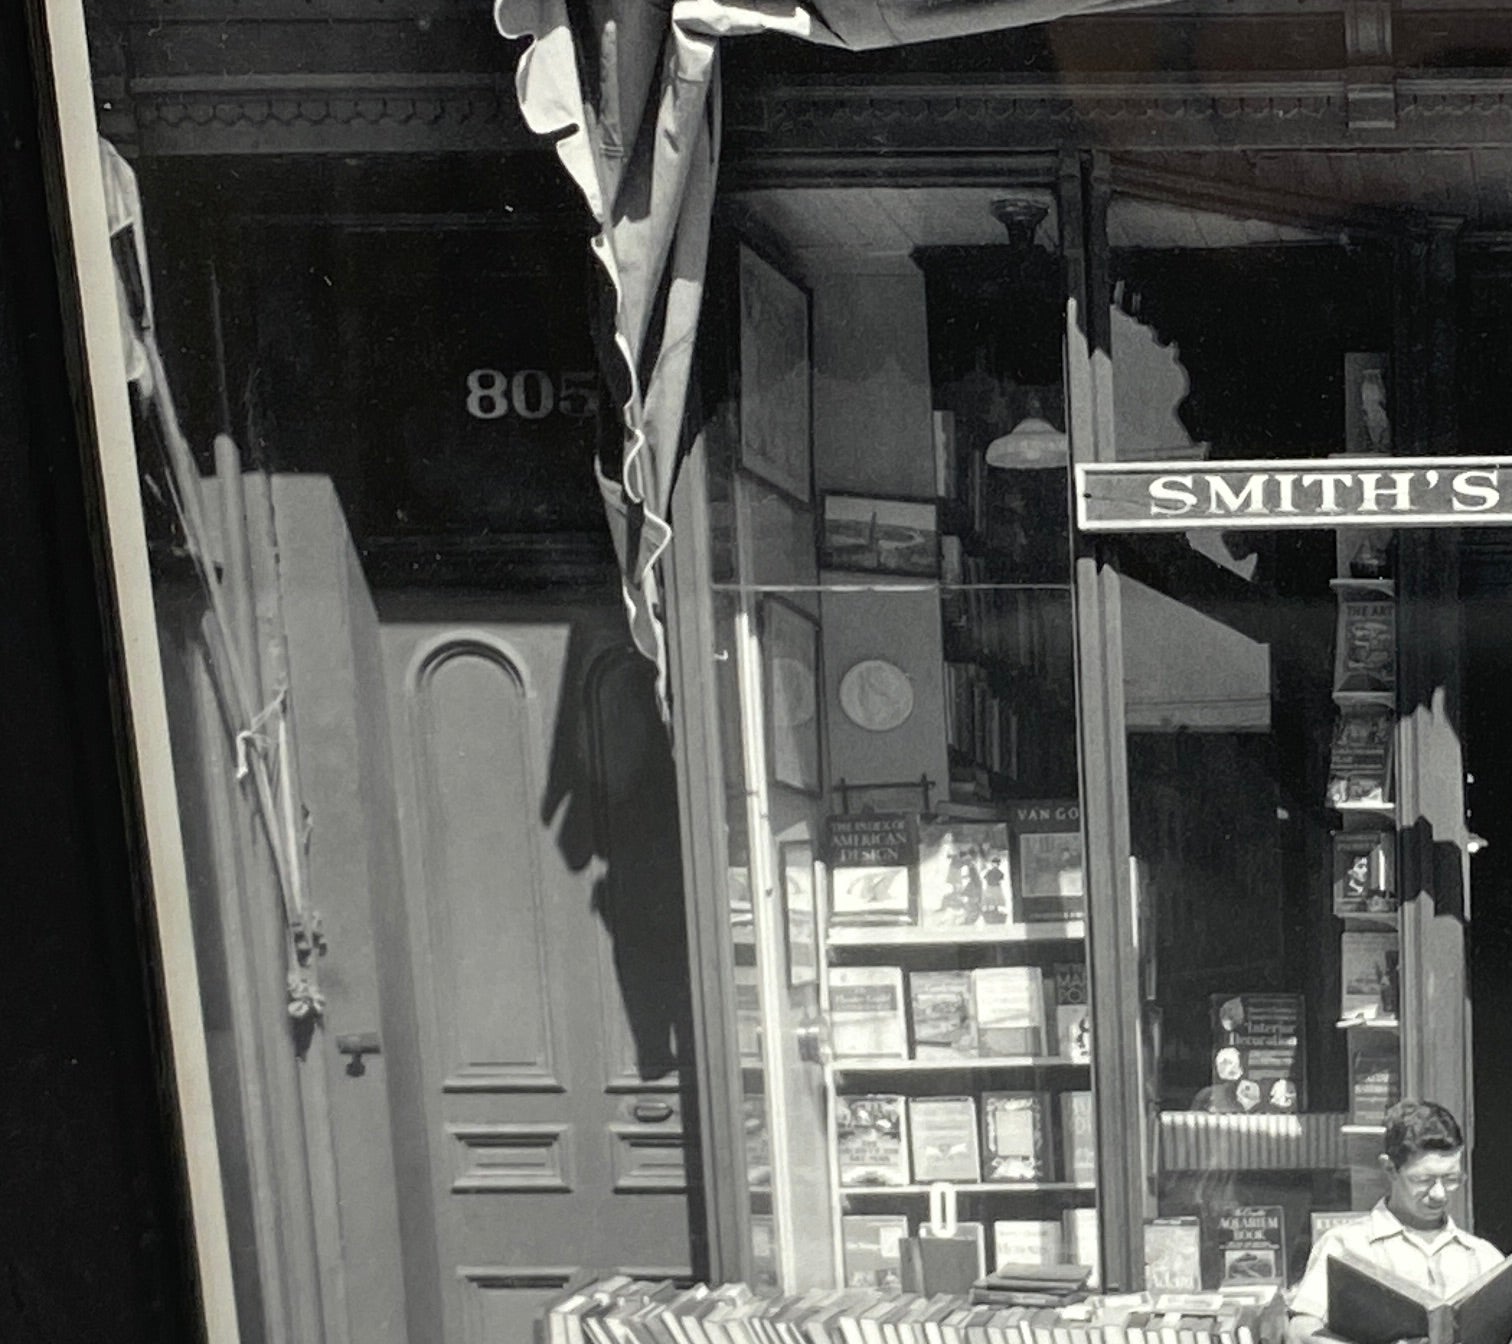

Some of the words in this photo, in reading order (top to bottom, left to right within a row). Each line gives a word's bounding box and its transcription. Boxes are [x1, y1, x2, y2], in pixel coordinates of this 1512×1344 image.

[466, 368, 598, 419] 805
[1148, 467, 1501, 516] SMITH'S
[1017, 807, 1050, 821] VAN
